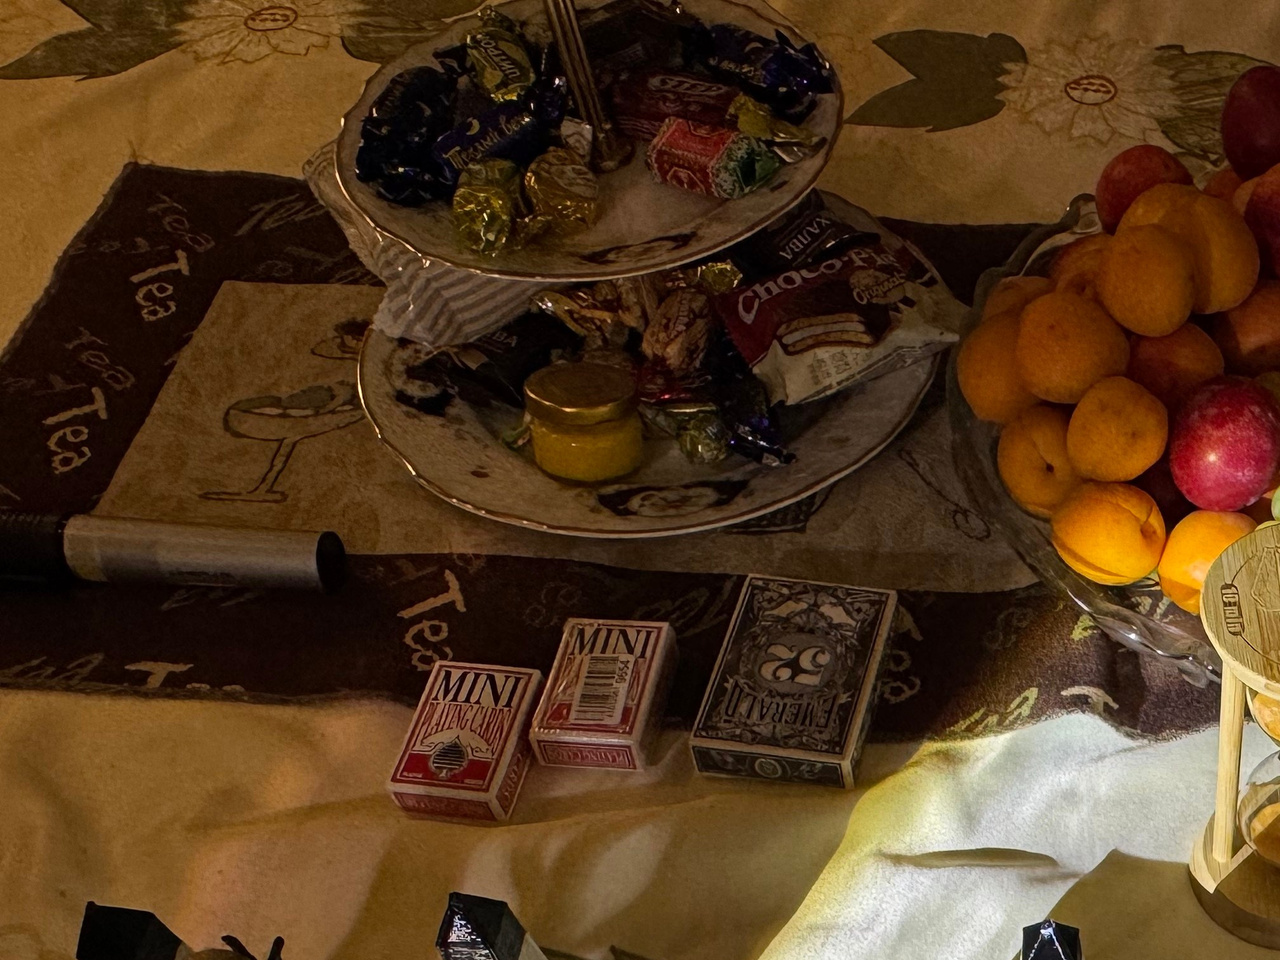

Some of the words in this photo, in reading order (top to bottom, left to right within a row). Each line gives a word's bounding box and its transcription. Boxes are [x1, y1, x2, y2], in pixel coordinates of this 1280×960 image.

[778, 215, 832, 261] ХАЛВА
[130, 249, 190, 322] Tea
[42, 386, 109, 474] Tea
[569, 627, 655, 659] MINI
[759, 643, 831, 686] 52
[432, 669, 524, 708] MINI
